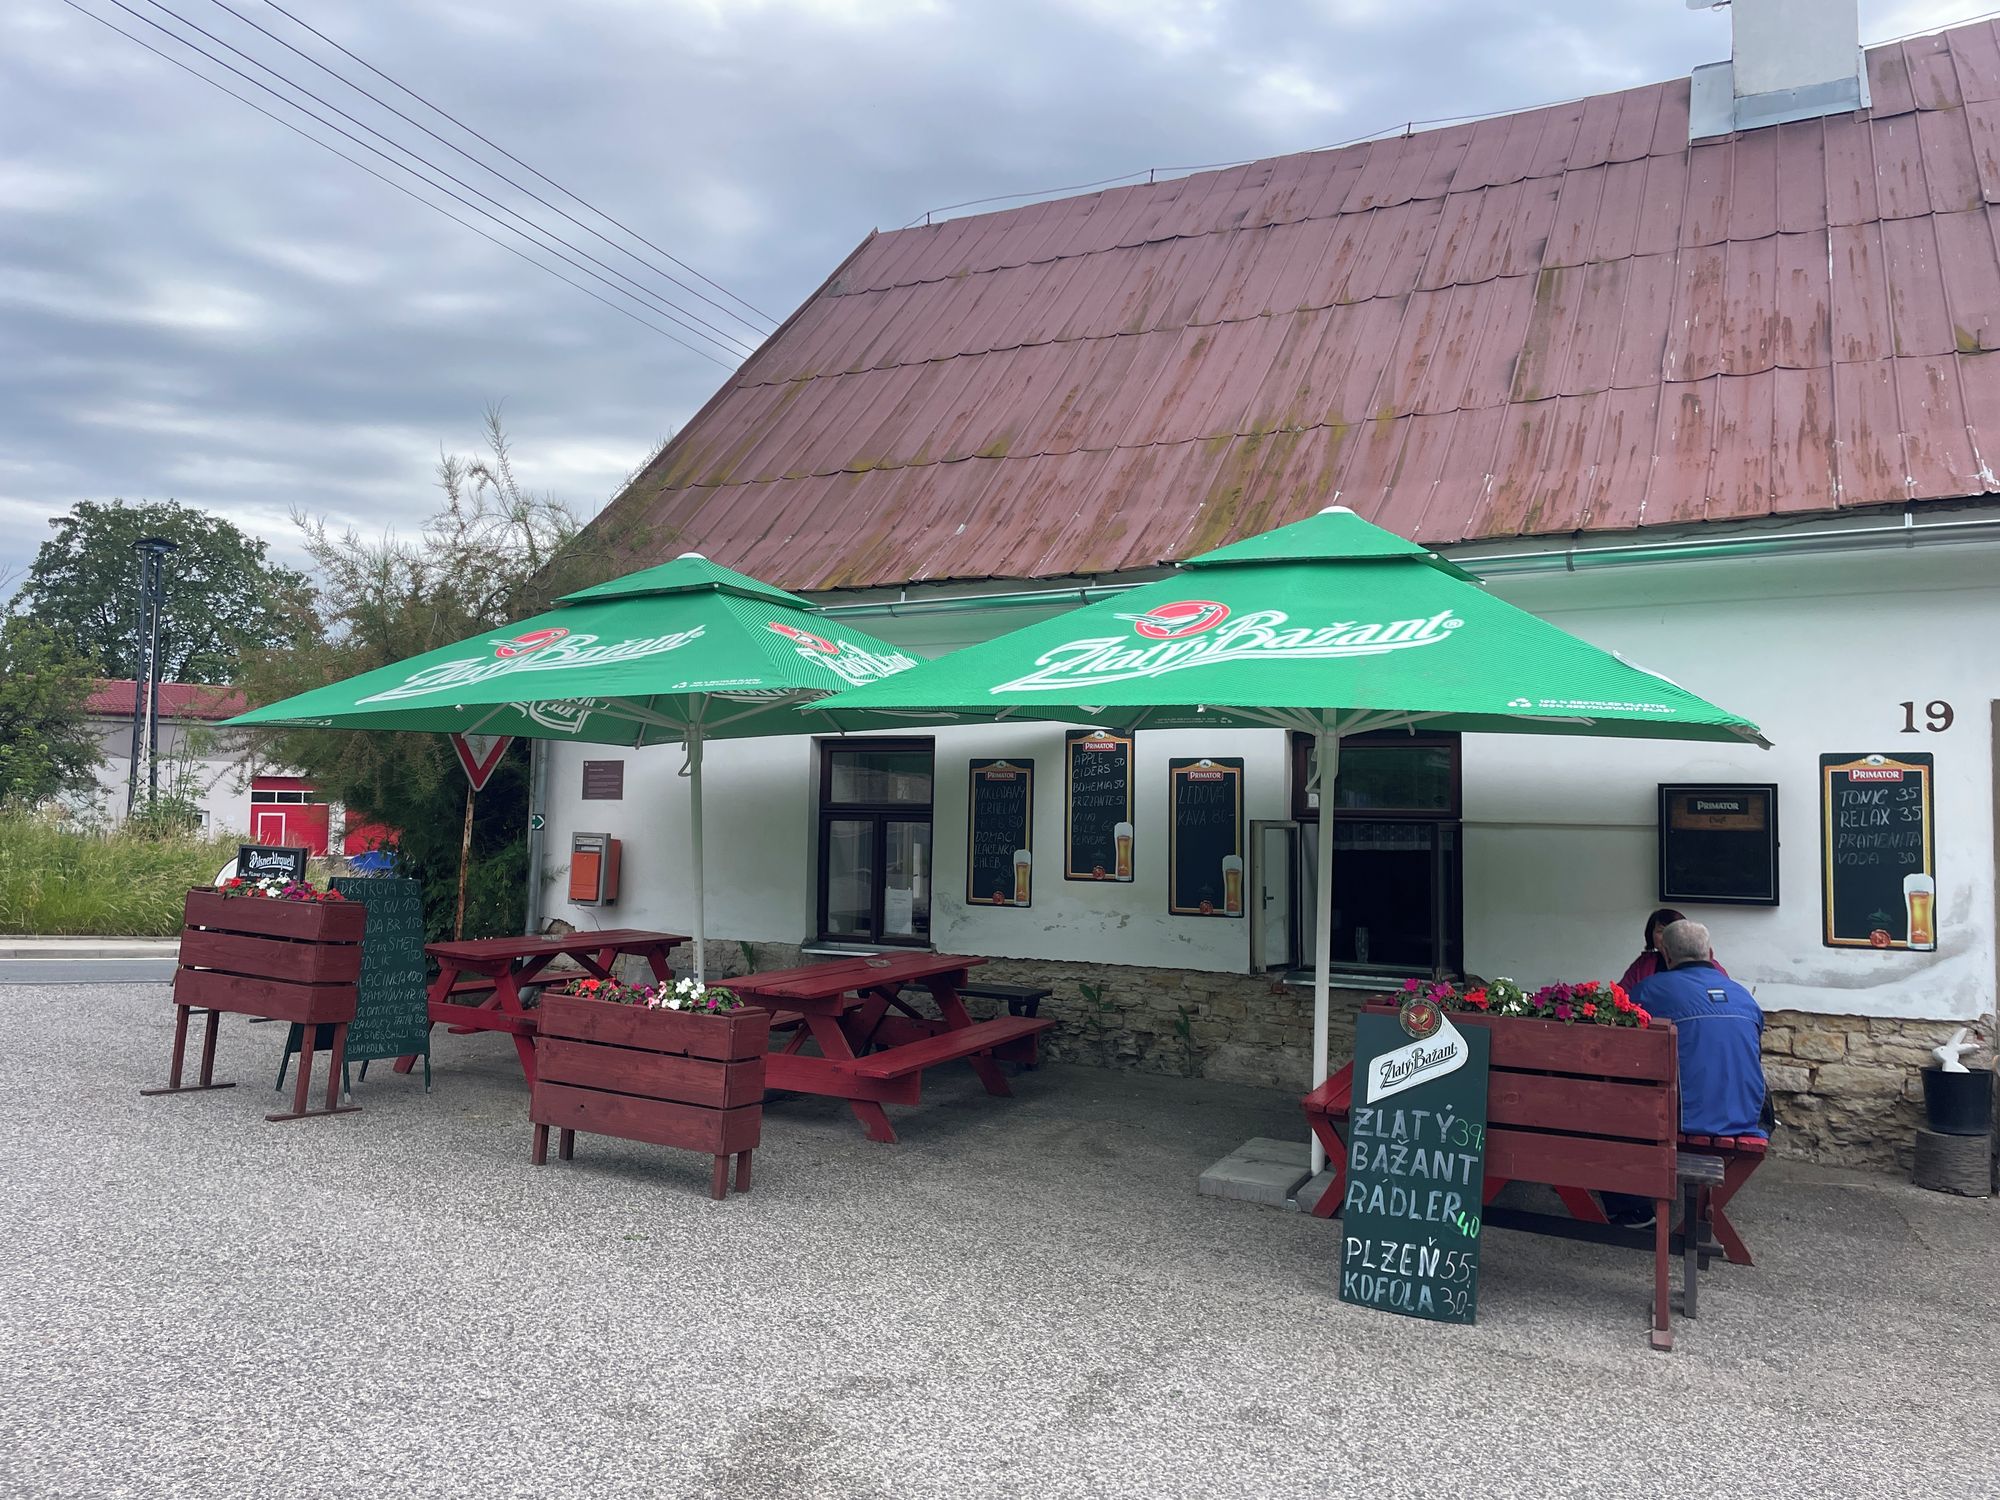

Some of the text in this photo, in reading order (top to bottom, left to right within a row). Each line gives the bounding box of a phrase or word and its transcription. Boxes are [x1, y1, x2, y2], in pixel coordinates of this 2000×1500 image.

[990, 610, 1454, 695] Zlatý Bažant
[1899, 700, 1954, 733] 19
[1085, 741, 1114, 750] PRIMATOR
[1072, 758, 1125, 779] CIDERS 50
[1074, 752, 1103, 766] APPLE
[1190, 771, 1221, 780] PRIMATOR
[1853, 769, 1900, 779] PRIMATOR
[1073, 781, 1112, 793] BOHEMIA
[1840, 787, 1920, 807] TONIC 35
[1697, 801, 1739, 810] PRIMATOR
[1840, 806, 1922, 828] RELAX 35
[1898, 852, 1915, 864] 30
[405, 916, 423, 930] 150
[1381, 1042, 1458, 1089] Zlatý Bažant
[1353, 1104, 1455, 1143] ZLATÝ
[1351, 1139, 1479, 1185] BAŽANT
[1457, 1211, 1480, 1239] 40
[1346, 1236, 1440, 1278] PLZEŇ
[1344, 1270, 1435, 1313] KOFOLA
